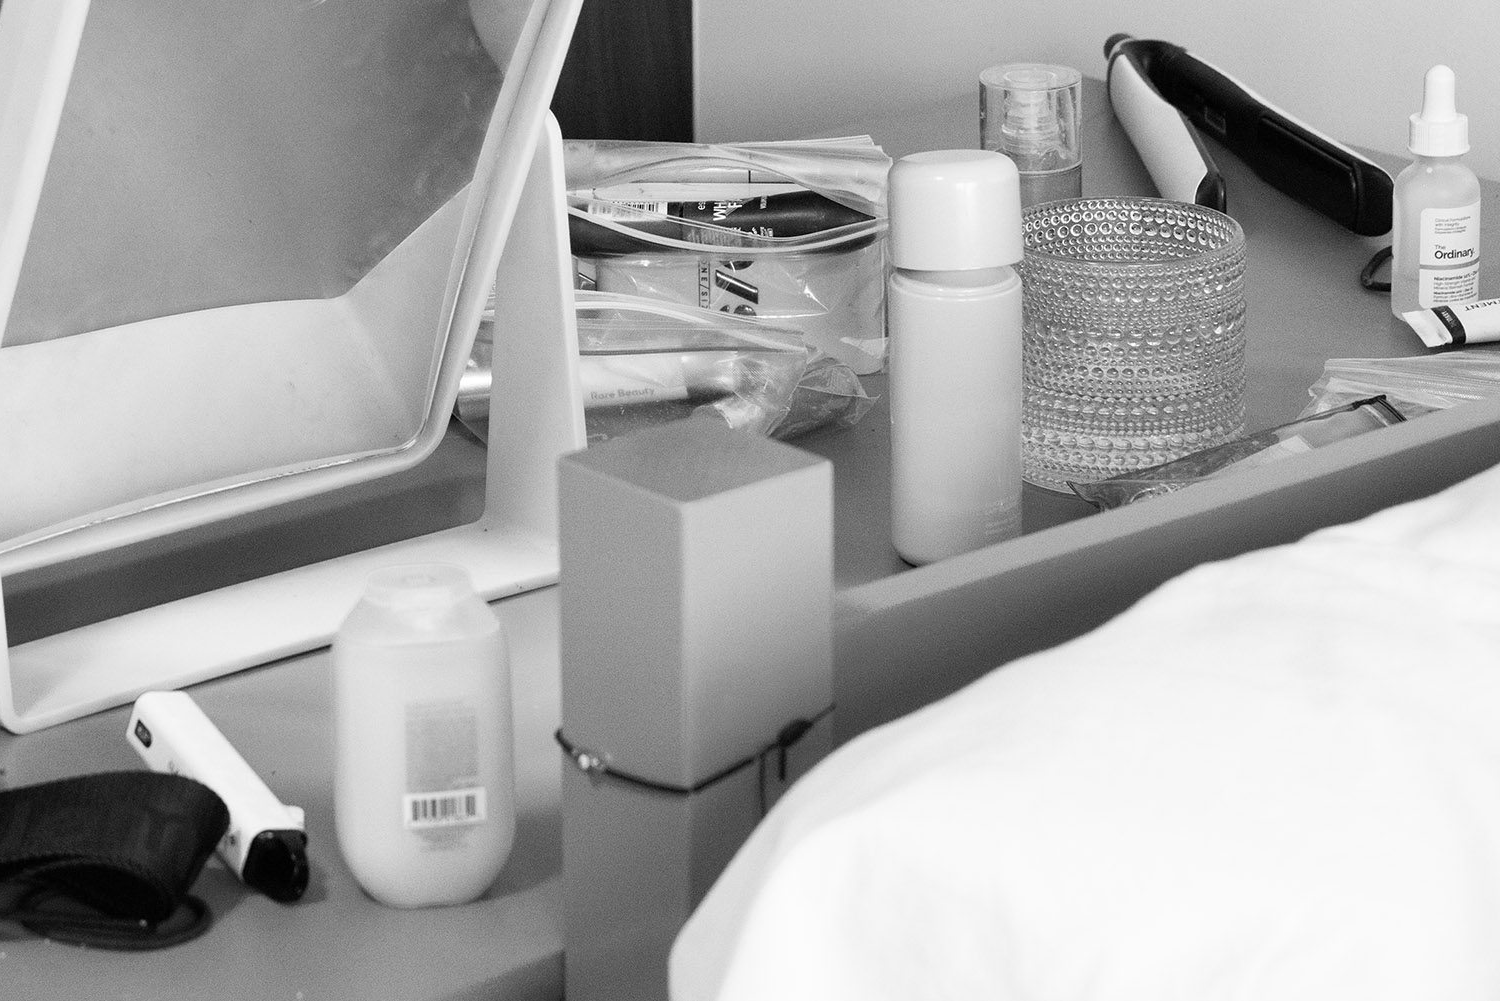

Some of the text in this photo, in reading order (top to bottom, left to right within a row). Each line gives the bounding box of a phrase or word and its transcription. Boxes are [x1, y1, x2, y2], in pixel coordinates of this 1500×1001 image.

[713, 200, 727, 221] WH
[1464, 300, 1500, 312] MENT
[590, 387, 655, 400] Rare Beauty
